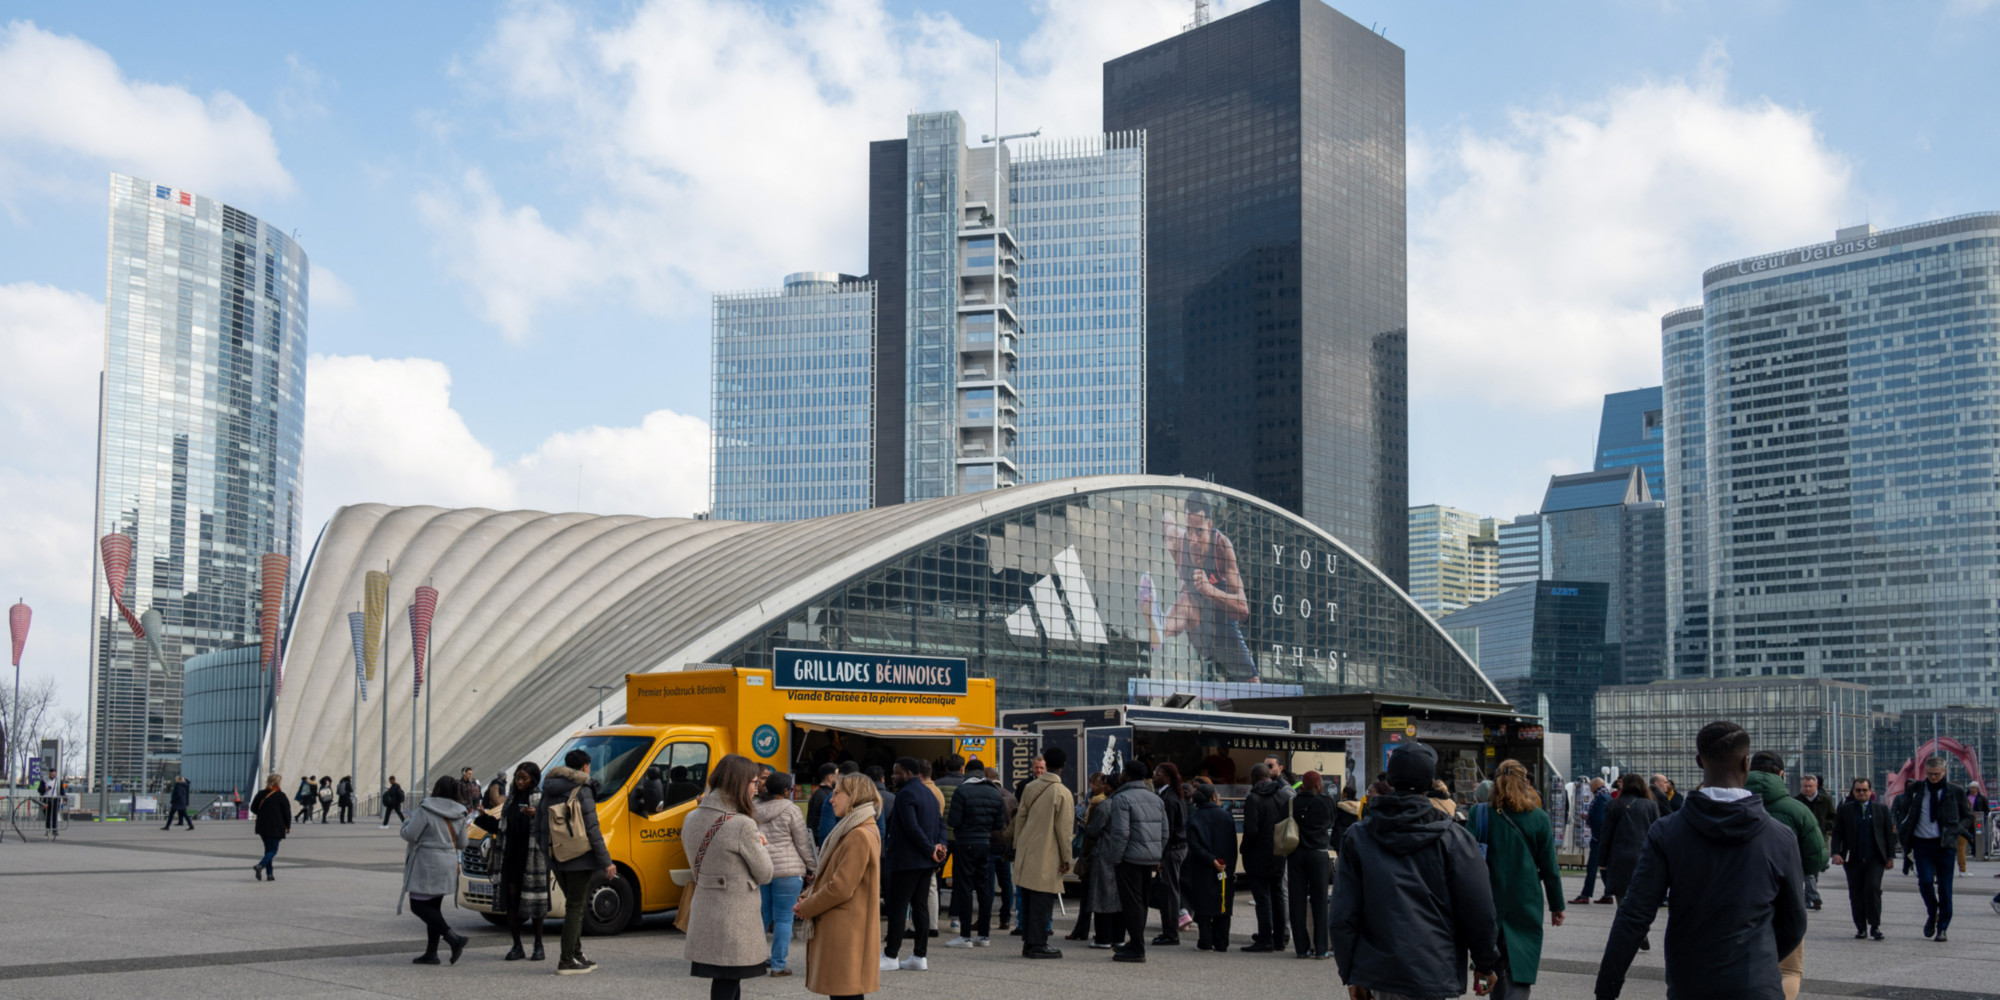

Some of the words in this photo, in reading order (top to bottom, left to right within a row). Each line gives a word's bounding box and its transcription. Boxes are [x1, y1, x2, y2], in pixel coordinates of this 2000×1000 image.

[1738, 254, 1788, 275] Cœur
[1272, 544, 1337, 574] YOU
[1272, 594, 1338, 622] GOT
[793, 658, 870, 683] GRILLADES
[875, 660, 952, 686] BÉNINOISES
[637, 687, 662, 697] Premier
[663, 685, 696, 698] foodtruck
[696, 683, 726, 695] Béninois
[788, 690, 822, 702] Viande
[824, 691, 860, 702] Braisée
[861, 692, 868, 702] à
[869, 692, 878, 703] la
[879, 694, 908, 706] pierre
[909, 694, 956, 707] volcanique
[1233, 738, 1268, 749] URBAN
[1274, 740, 1317, 750] SMOKER
